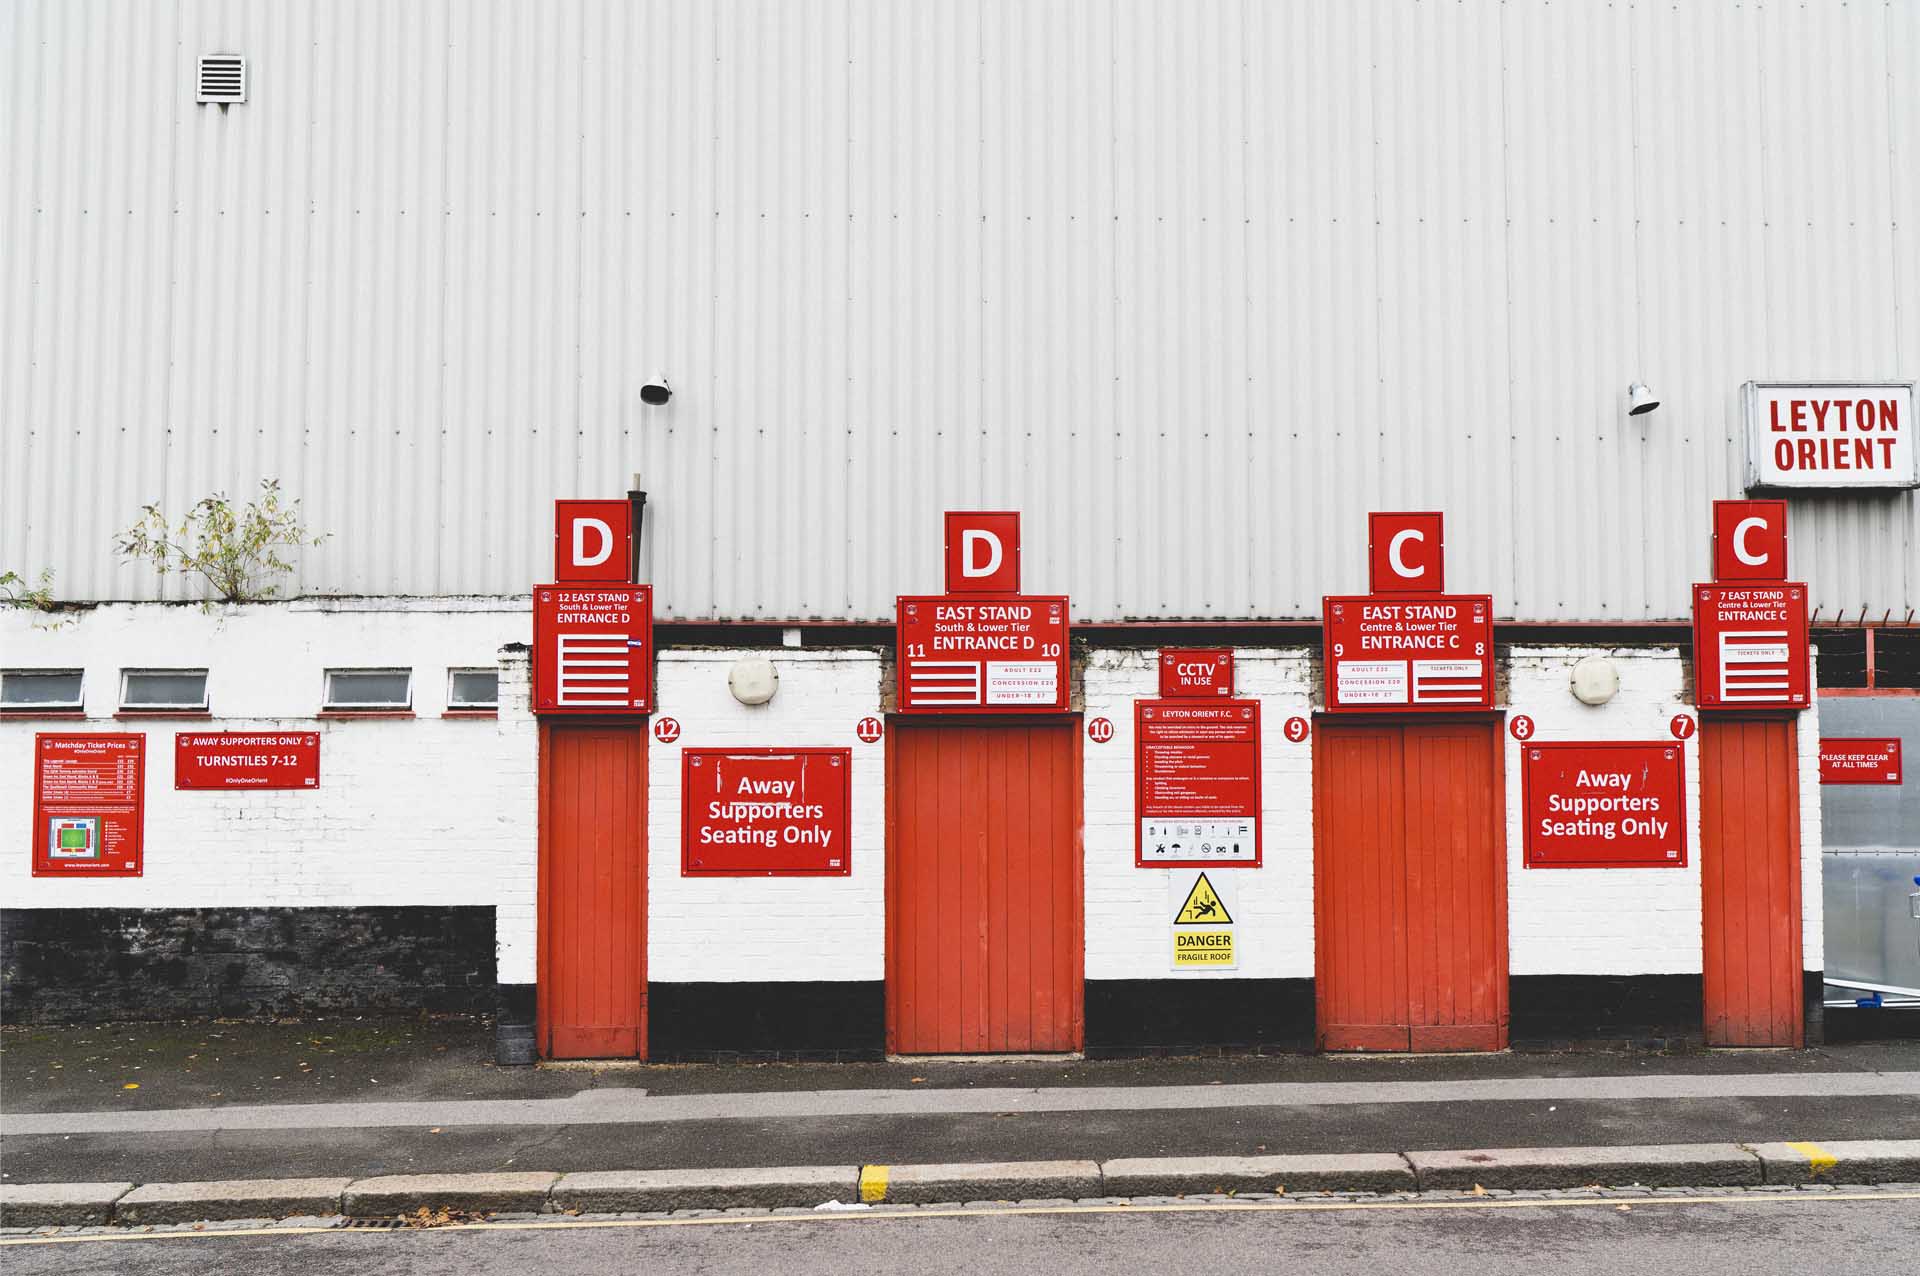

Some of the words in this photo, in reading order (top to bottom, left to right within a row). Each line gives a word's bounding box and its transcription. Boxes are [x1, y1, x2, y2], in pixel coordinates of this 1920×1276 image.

[1770, 399, 1898, 432] LEYTON
[1774, 438, 1896, 471] ORIENT
[573, 518, 613, 566] D
[1733, 517, 1768, 566] C
[962, 530, 1002, 577] D
[1389, 529, 1424, 578] C
[558, 593, 569, 602] 12
[572, 593, 595, 602] EAST
[598, 593, 629, 602] STAND
[1720, 592, 1725, 600] 7
[1728, 592, 1751, 600] EAST
[1753, 591, 1783, 599] STAND
[557, 613, 618, 623] ENTRANCE
[622, 613, 630, 623] D
[936, 606, 975, 620] EAST
[979, 606, 1031, 620] STAND
[1363, 606, 1401, 620] EAST
[1405, 606, 1457, 619] STAND
[1718, 611, 1777, 620] ENTRANCE
[1780, 611, 1787, 620] C
[935, 623, 964, 632] South
[967, 623, 975, 632] &
[978, 623, 1008, 632] Lower
[1011, 623, 1030, 632] Tier
[1360, 622, 1392, 632] Centre
[1395, 622, 1403, 632] &
[1405, 622, 1436, 631] Lower
[1438, 622, 1457, 631] Tier
[933, 636, 1018, 650] ENTRANCE
[1024, 636, 1034, 650] D
[1362, 635, 1444, 649] ENTRANCE
[1450, 635, 1460, 648] C
[1475, 642, 1484, 655] 8
[907, 644, 925, 657] 11
[1042, 644, 1060, 656] 10
[1334, 644, 1343, 657] 9
[1177, 663, 1215, 676] CCTV
[1181, 677, 1191, 685] IN
[1194, 677, 1212, 685] USE
[656, 720, 678, 739] 12
[859, 720, 881, 738] 11
[1091, 720, 1112, 739] 10
[1290, 720, 1303, 740] 9
[1516, 719, 1528, 737] 8
[1677, 718, 1689, 736] 7
[193, 738, 218, 746] AWAY
[279, 737, 302, 745] ONLY
[196, 755, 268, 766] TURNSTILES
[271, 755, 297, 766] 7-12
[1576, 769, 1631, 791] Away
[737, 777, 795, 798] Away
[1549, 794, 1660, 815] Supporters
[709, 801, 823, 823] Supporters
[1541, 818, 1616, 840] Seating
[1621, 817, 1668, 839] Only
[700, 826, 777, 847] Seating
[783, 825, 832, 847] Only
[1177, 935, 1231, 946] DANGER
